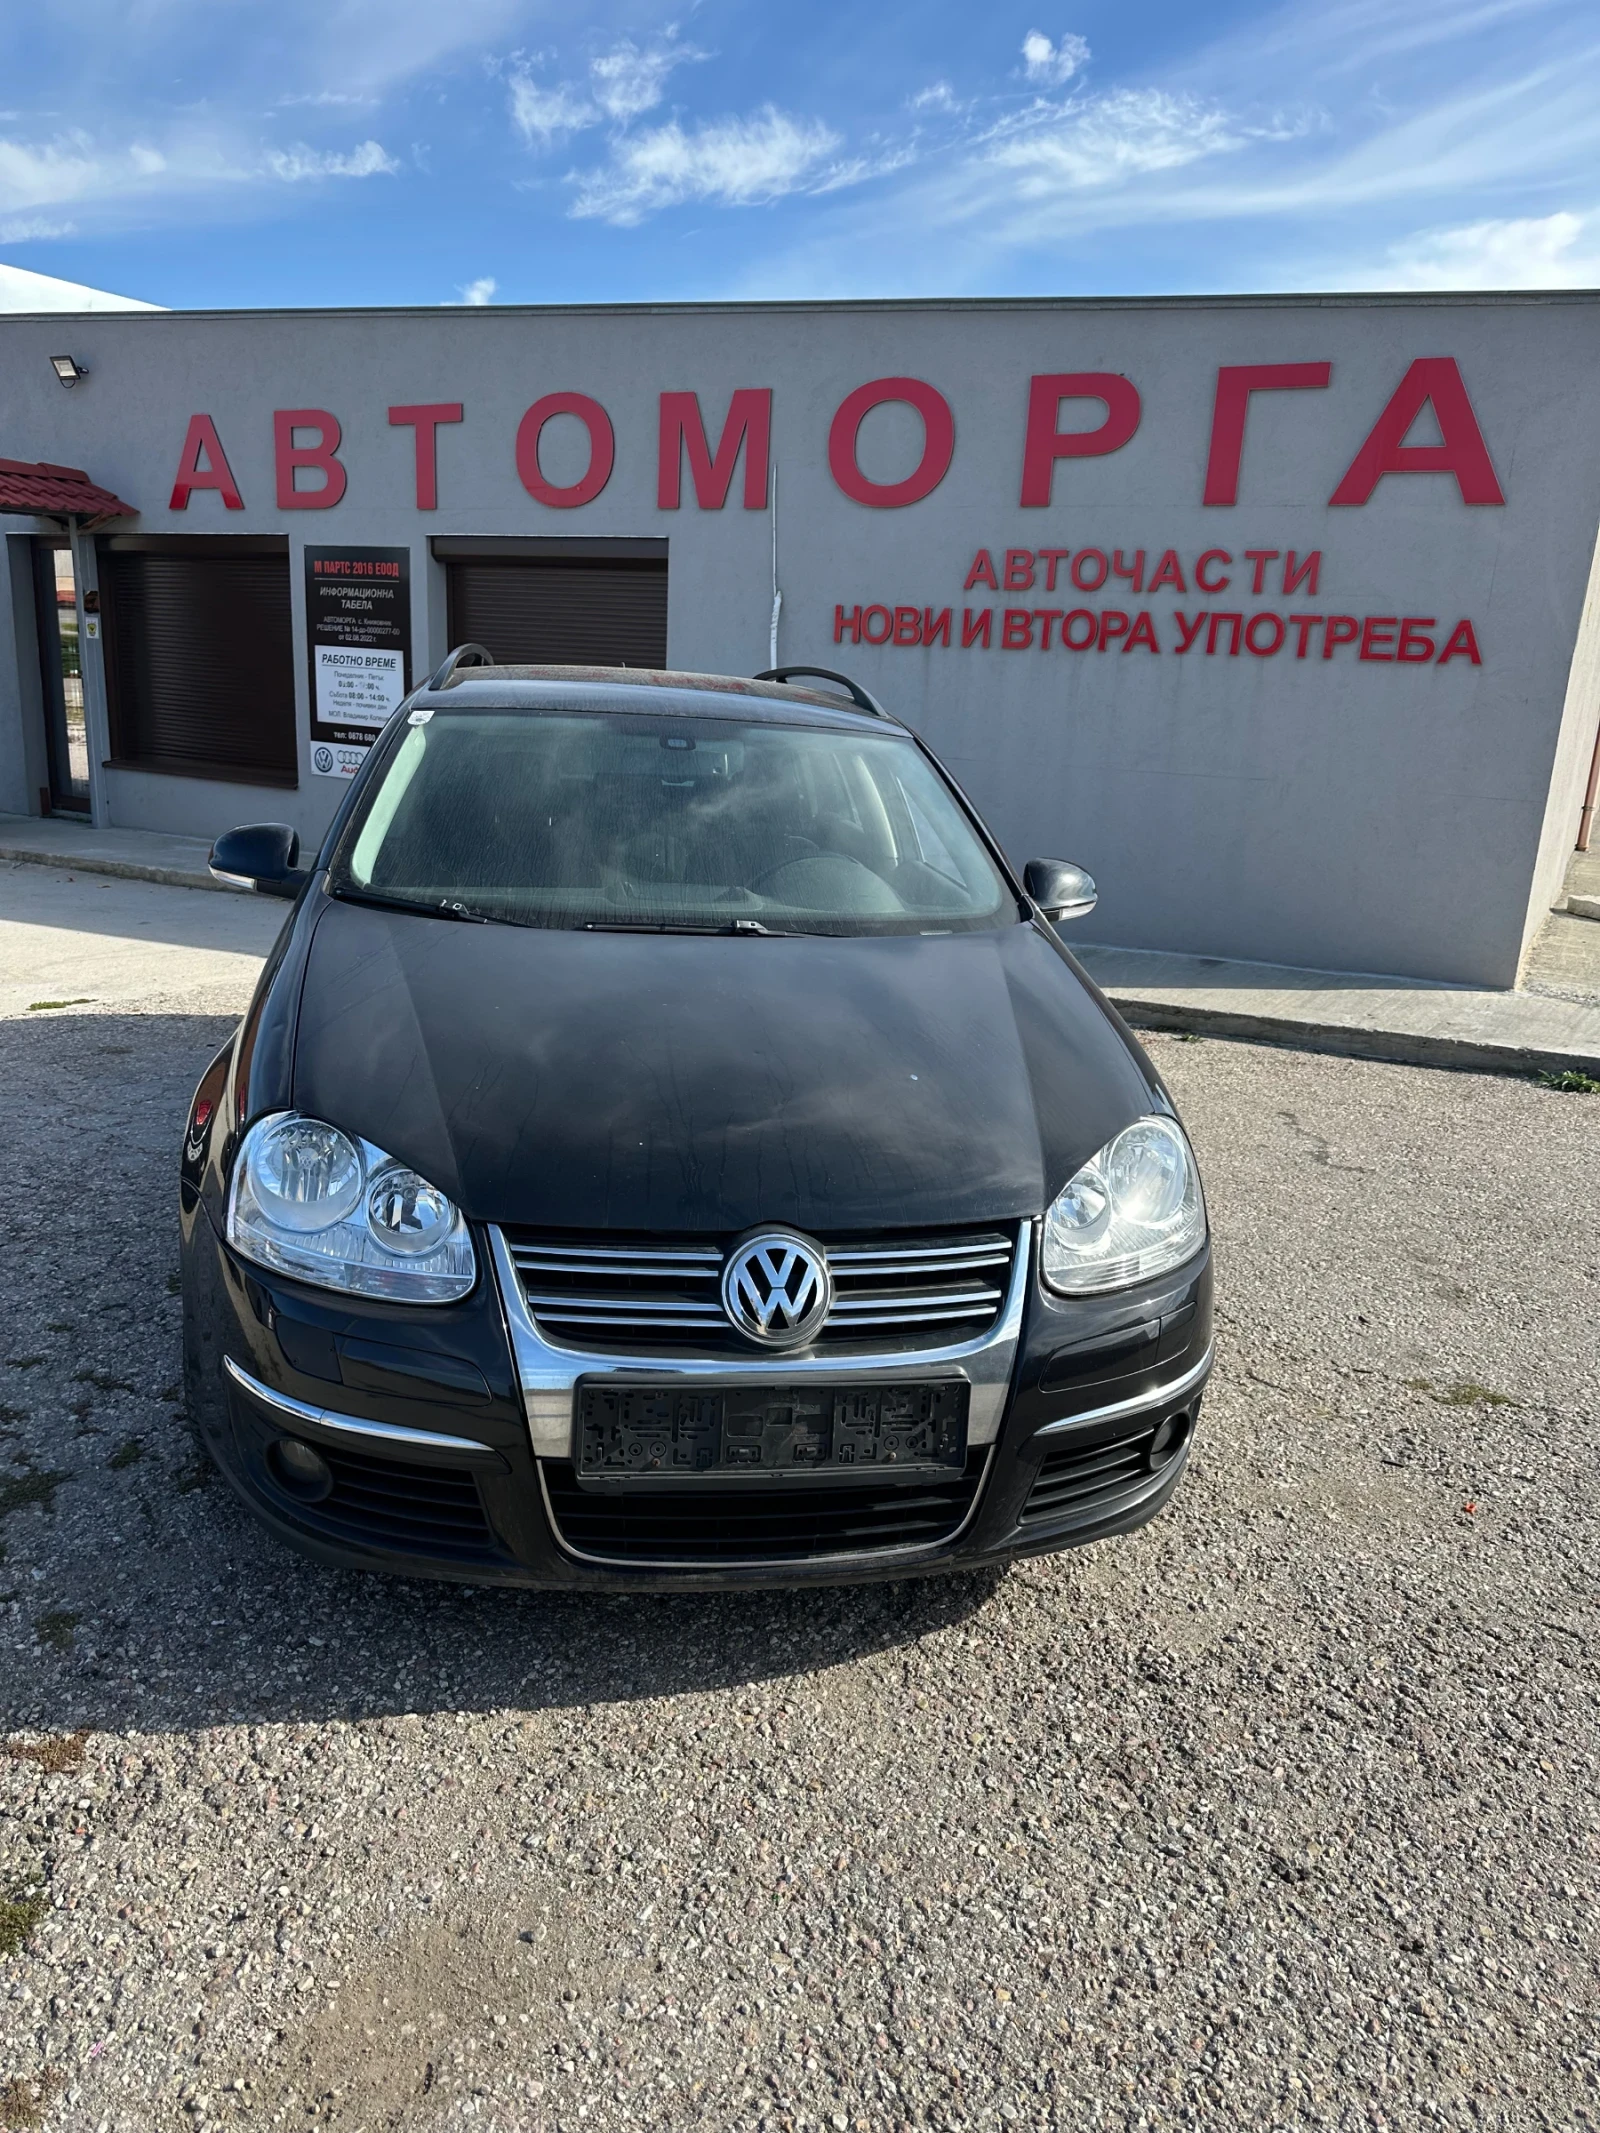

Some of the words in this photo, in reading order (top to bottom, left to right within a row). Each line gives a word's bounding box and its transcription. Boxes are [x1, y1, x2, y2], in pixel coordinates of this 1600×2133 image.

[168, 357, 1506, 512] АВТОМОРГА
[314, 560, 322, 573] М
[324, 560, 351, 574] ПАРТС
[353, 561, 373, 575] 2016
[375, 562, 399, 577] ЕООД
[964, 548, 1322, 596] АВТОЧАСТИ
[320, 586, 395, 599] ИНФОРМАЦИОННА
[341, 599, 373, 610] ТАБЕЛА
[323, 616, 357, 624] АВТОМОРГА
[316, 623, 344, 632] РЕШЕНИЕ
[832, 604, 952, 648] НОВИ
[961, 607, 992, 649] И
[1001, 608, 1161, 654] ВТОРА
[1174, 611, 1482, 666] УПОТРЕБА
[321, 653, 364, 667] РАБОТНО
[364, 658, 397, 669] ВРЕМЕ
[333, 670, 365, 679] Понеделник
[328, 690, 348, 699] Събота
[340, 764, 360, 775] Aud
[724, 1237, 831, 1342] VW
